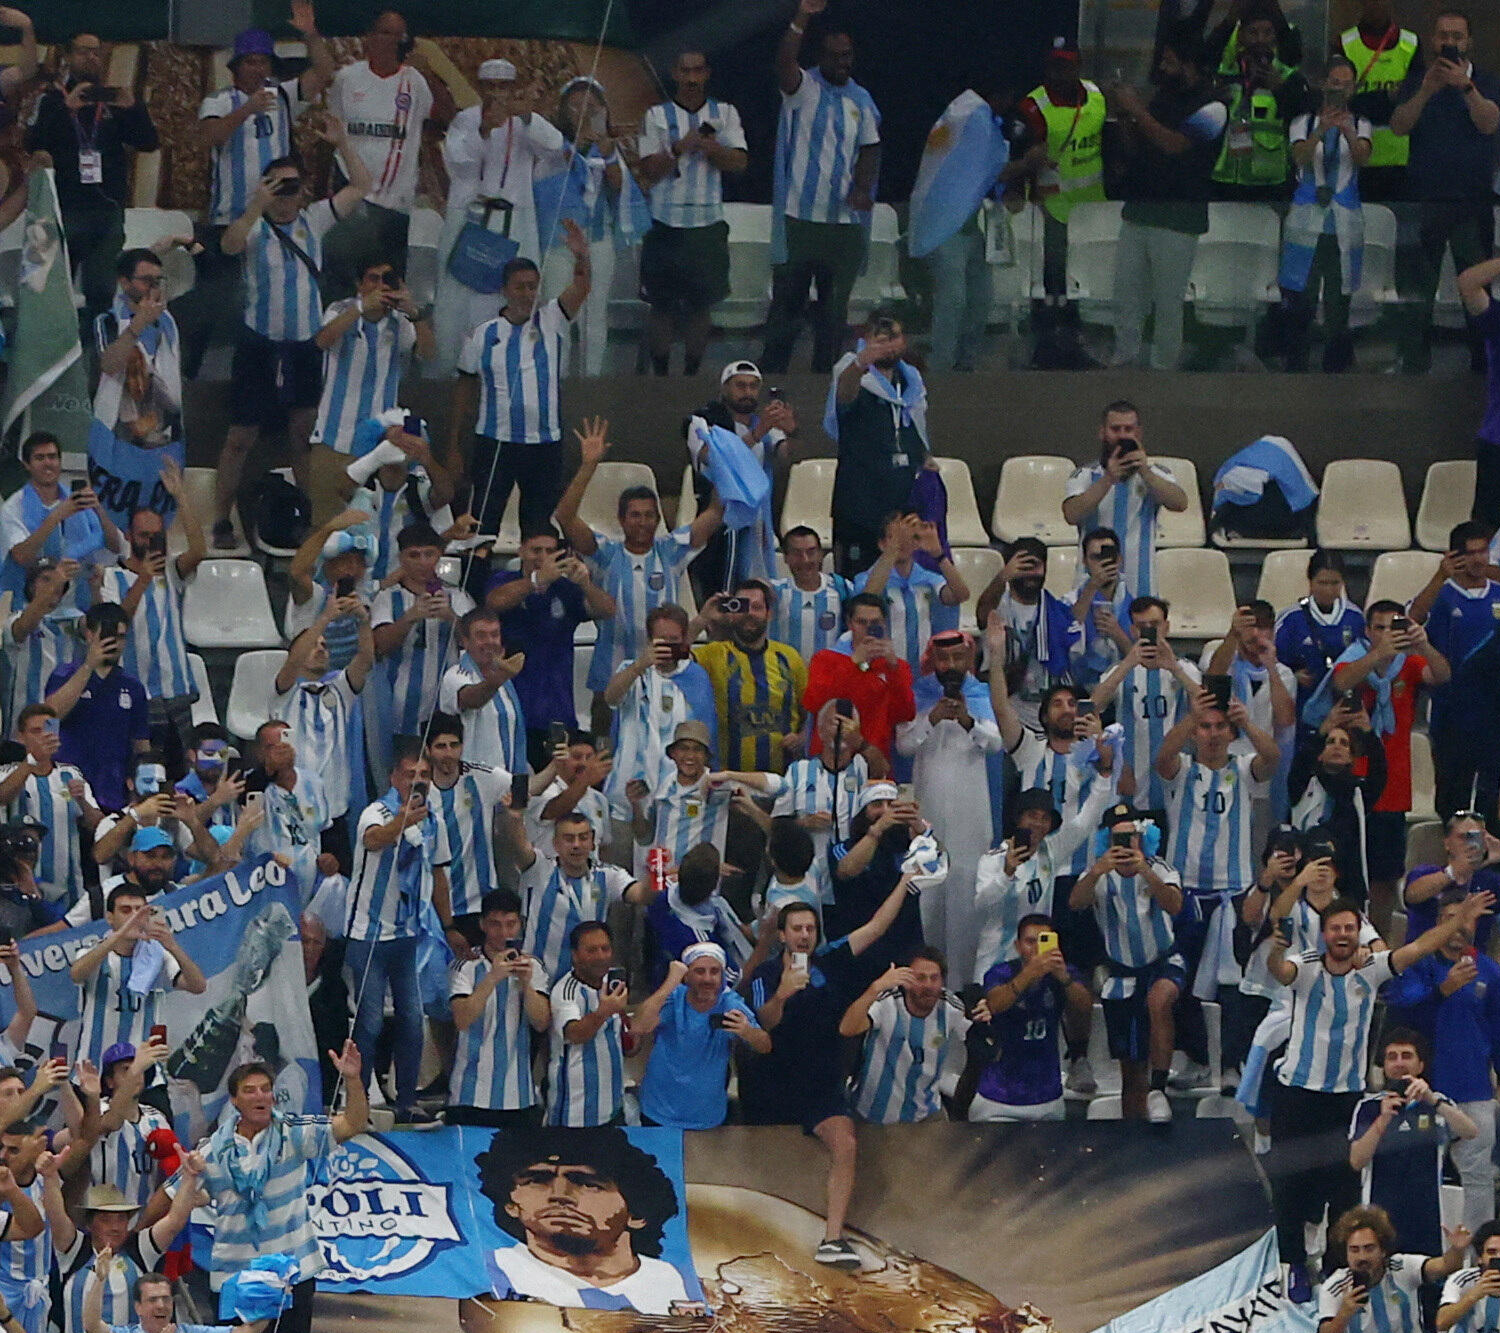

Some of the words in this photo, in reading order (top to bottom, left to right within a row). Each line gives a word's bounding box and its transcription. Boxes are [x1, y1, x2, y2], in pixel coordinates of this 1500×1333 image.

[253, 114, 273, 140] 10
[1141, 694, 1169, 719] 10
[1200, 790, 1225, 814] 10
[222, 859, 287, 916] Leo
